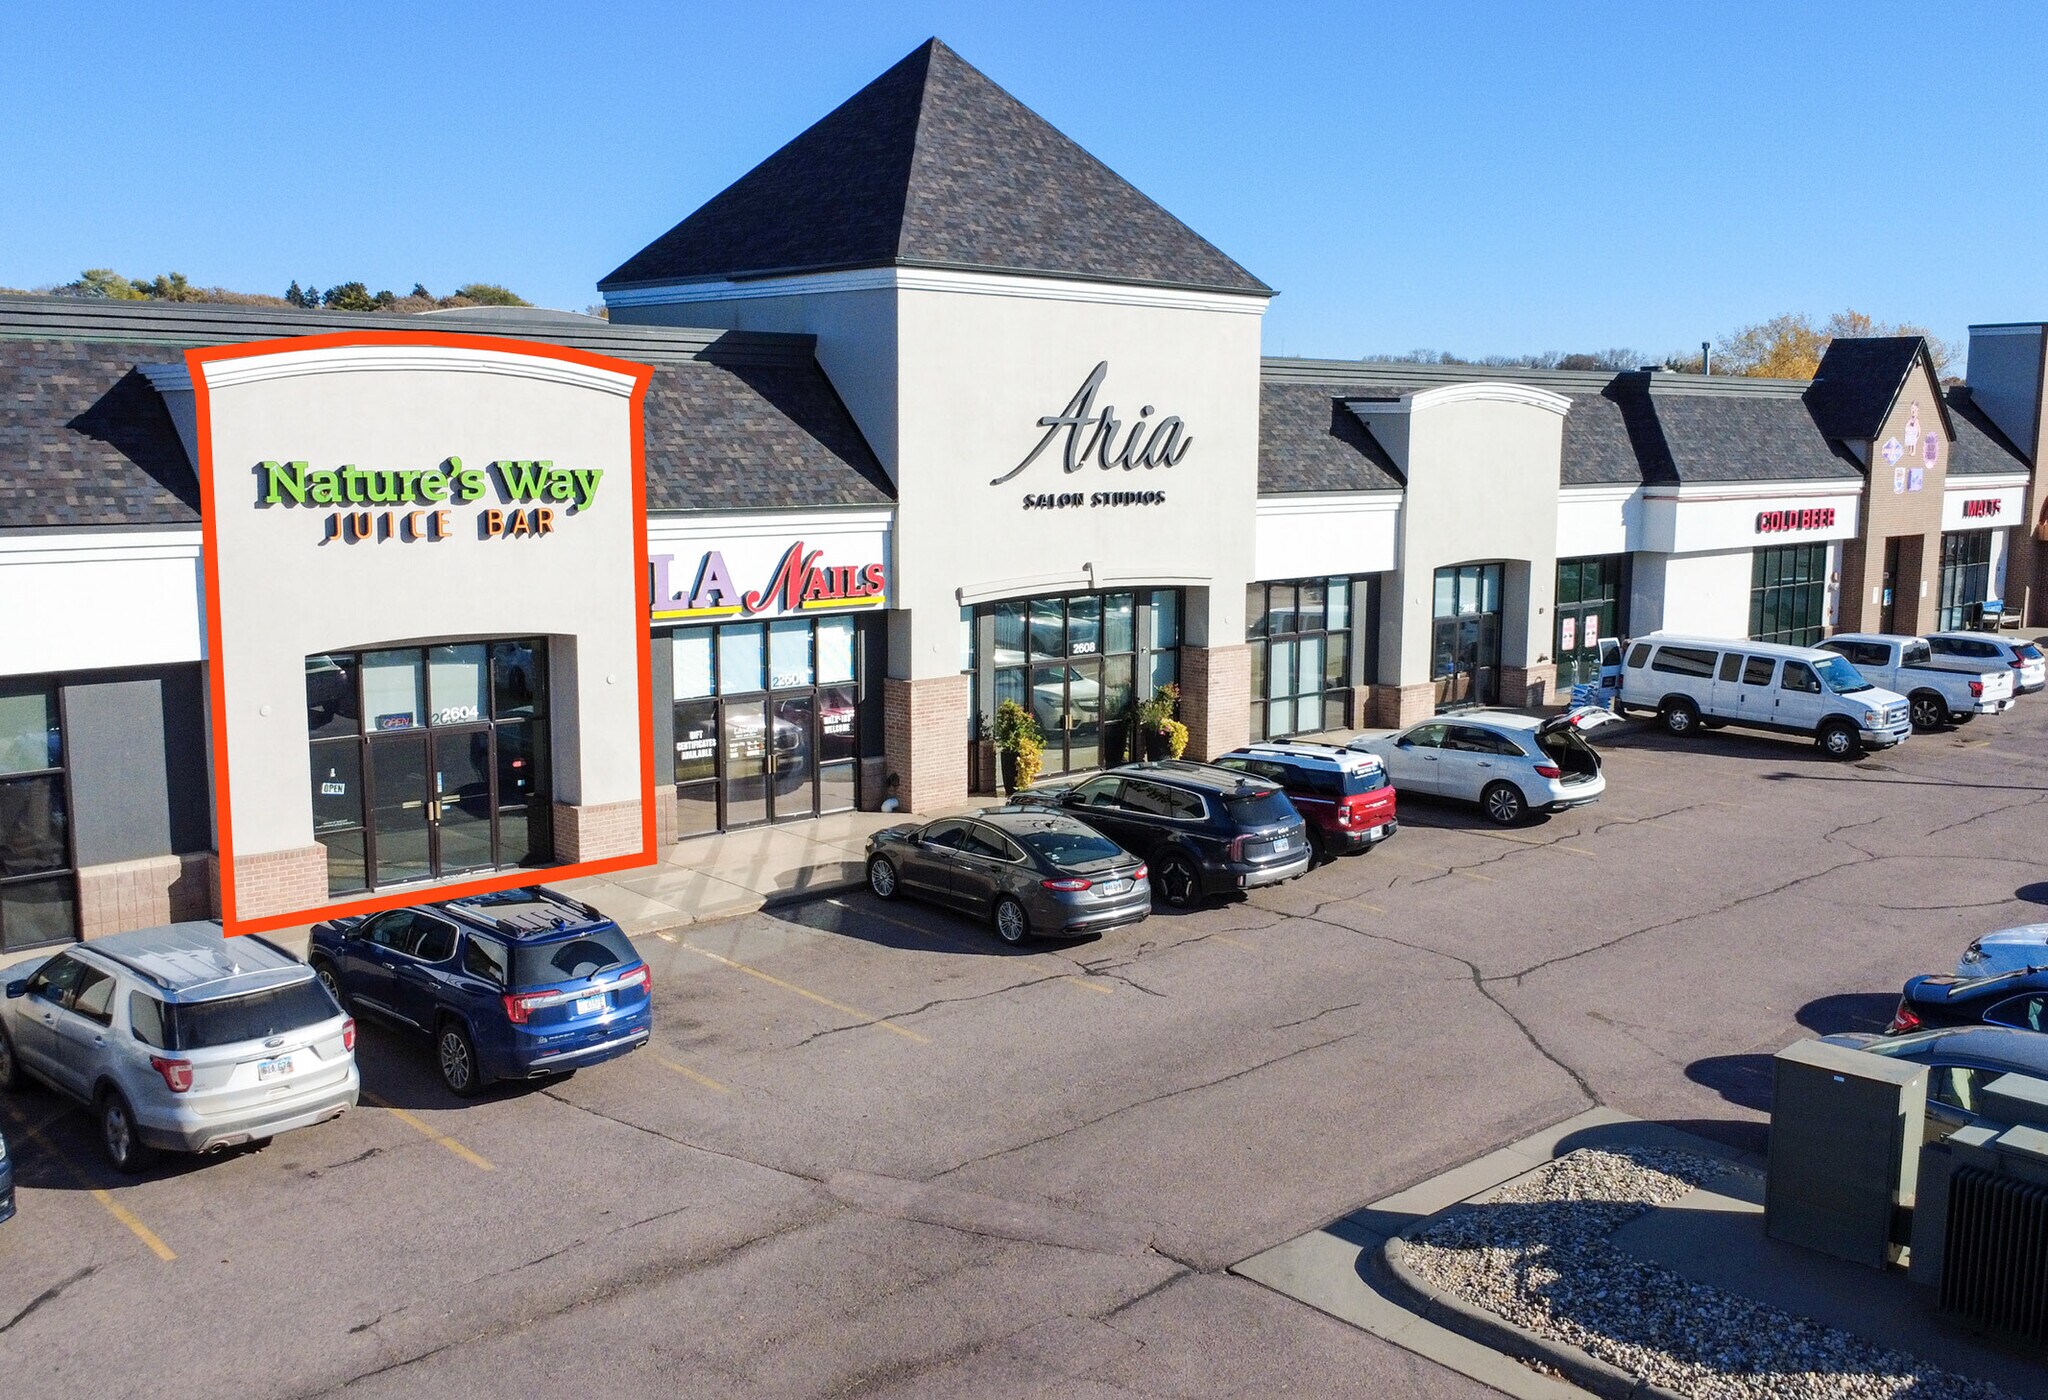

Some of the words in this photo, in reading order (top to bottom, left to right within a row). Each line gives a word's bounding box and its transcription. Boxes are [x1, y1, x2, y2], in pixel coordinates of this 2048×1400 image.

[990, 360, 1193, 486] Aria
[260, 456, 487, 504] Nature's
[494, 460, 604, 512] Way
[1023, 493, 1084, 509] SALON
[1090, 490, 1166, 508] STUDIOS
[325, 510, 452, 542] JUICE
[484, 508, 555, 538] BAR
[1758, 510, 1798, 532] COLD
[1801, 508, 1835, 529] BEER
[1073, 641, 1096, 654] 2608
[382, 717, 410, 728] OPEN
[441, 705, 479, 721] 2604
[323, 783, 343, 793] OPEN
